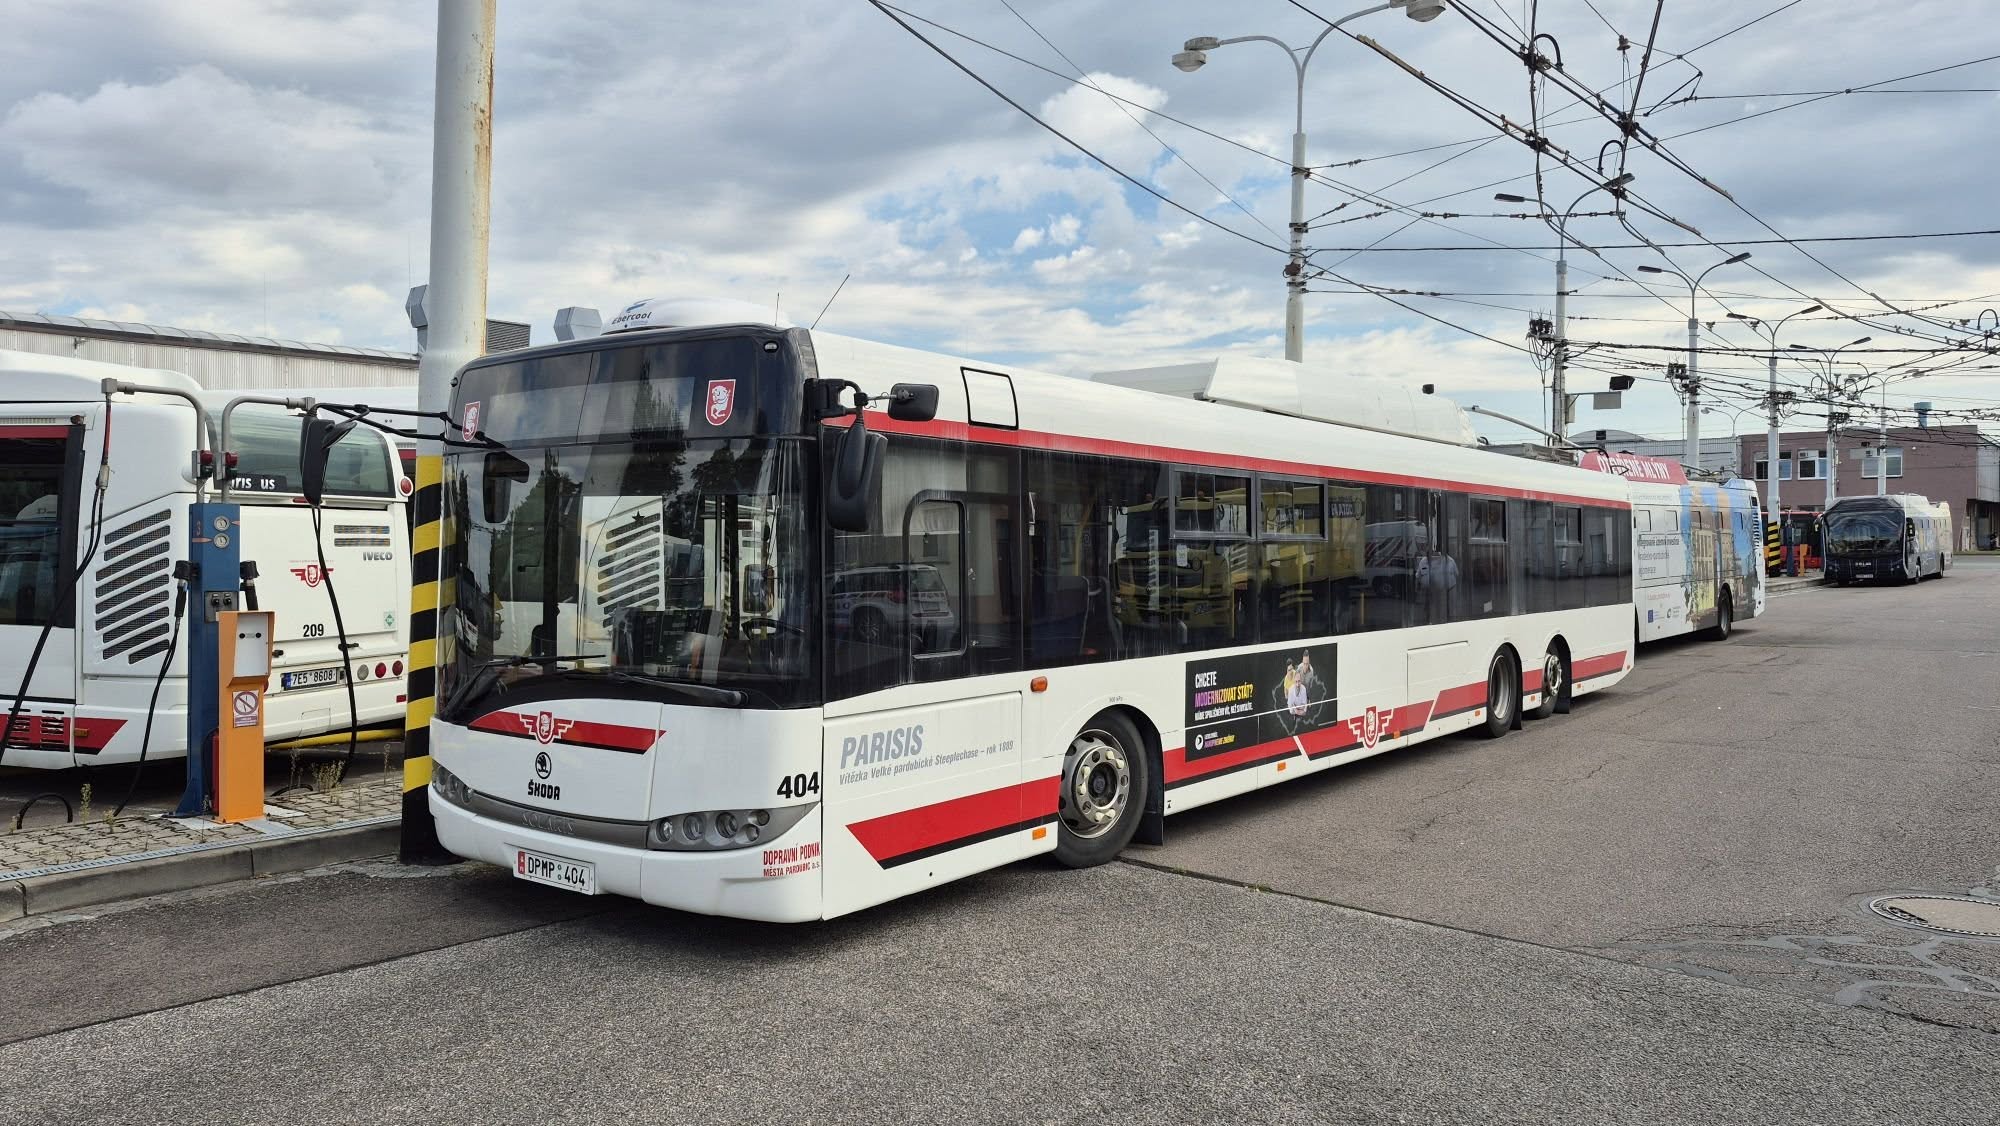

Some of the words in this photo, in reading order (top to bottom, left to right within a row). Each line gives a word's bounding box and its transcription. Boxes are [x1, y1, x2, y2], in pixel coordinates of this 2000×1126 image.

[362, 551, 393, 561] IVECO
[303, 623, 325, 637] 209
[292, 673, 308, 686] 7E5
[313, 669, 333, 682] 8608
[1195, 671, 1217, 689] CHCETE
[1195, 686, 1237, 708] MODERNIZOVAT
[1237, 682, 1254, 701] STÁT?
[840, 724, 924, 770] PARISIS
[839, 770, 868, 785] Vítězka
[871, 763, 891, 778] Velké
[987, 743, 996, 755] rok
[527, 778, 560, 801] ŠKODA
[777, 771, 820, 799] 404
[763, 843, 798, 866] DOPRAVNÍ
[799, 841, 820, 860] PODNIK
[528, 857, 555, 879] DPMP
[564, 866, 585, 887] 404
[763, 865, 784, 877] MĚSTA
[785, 860, 810, 876] PARDUBIC
